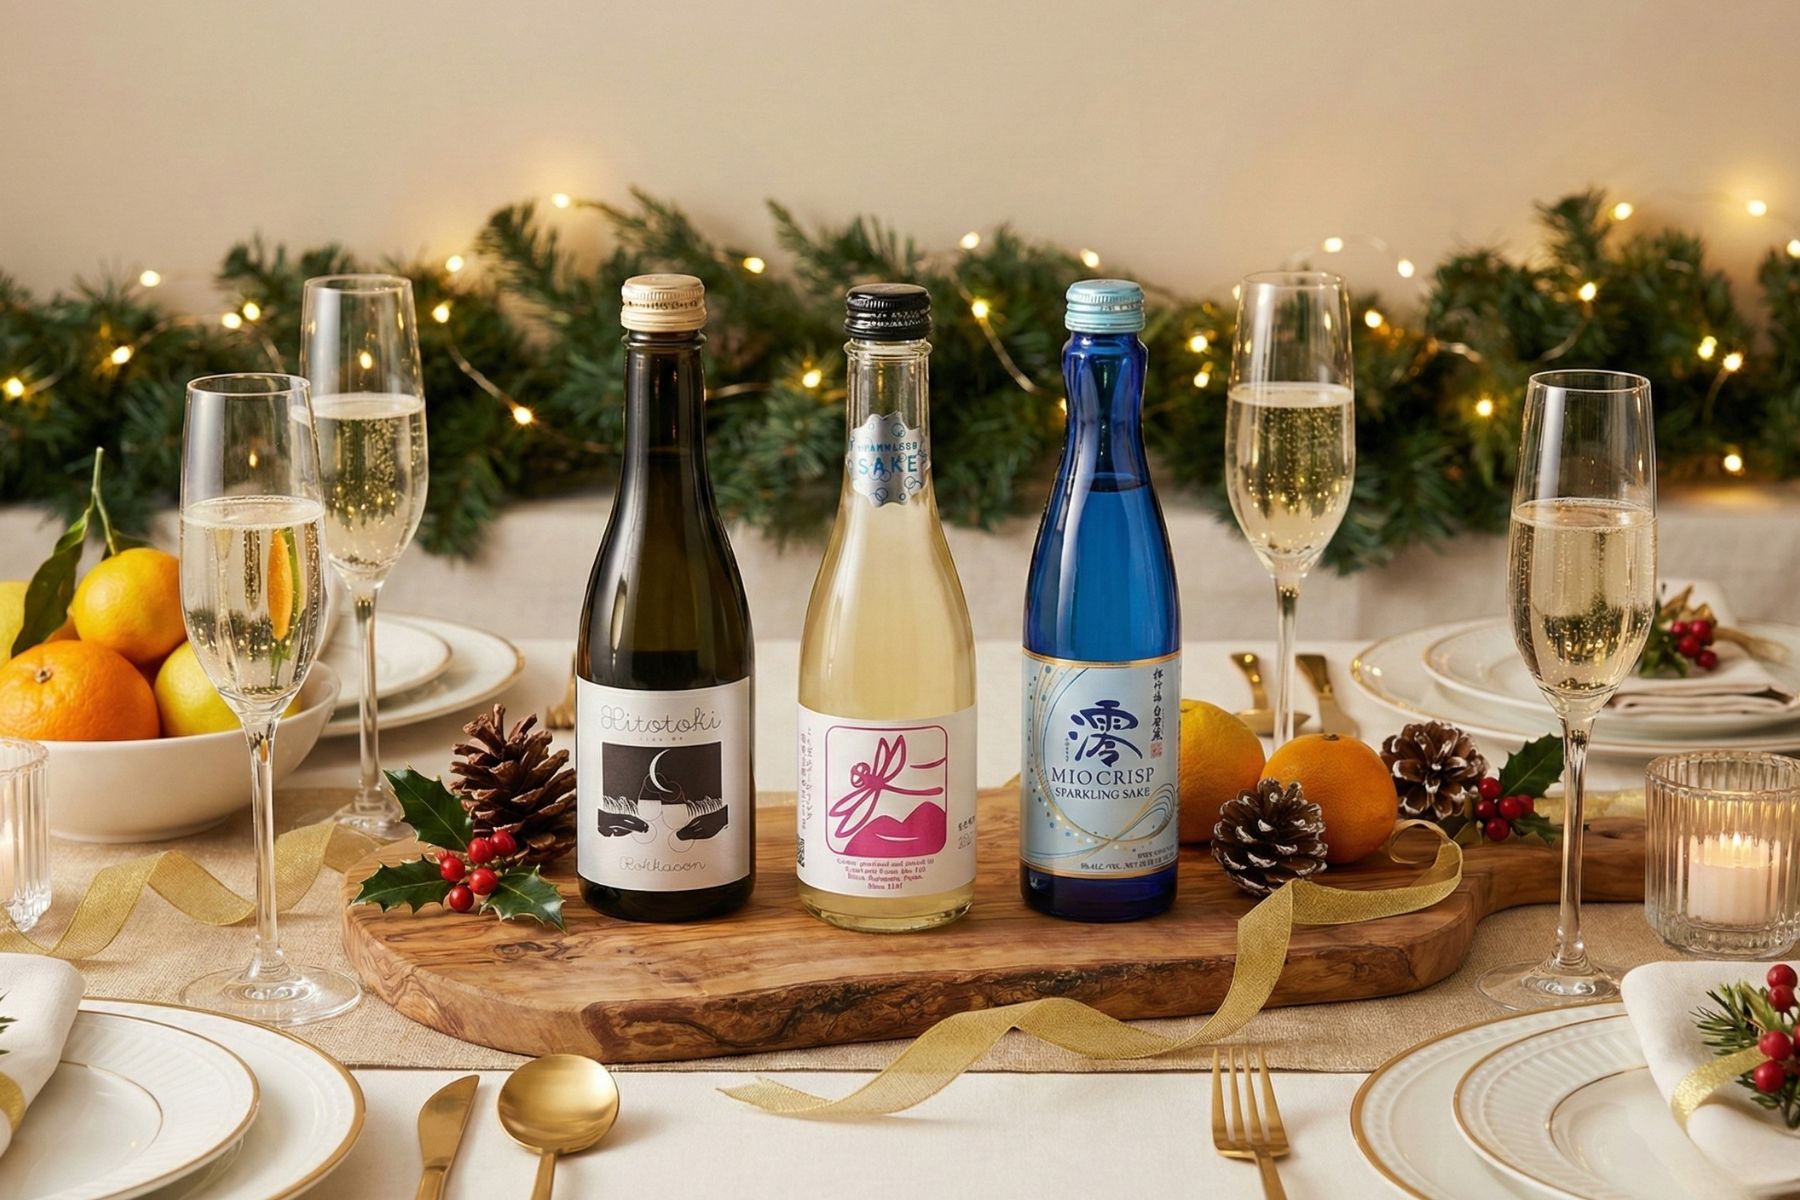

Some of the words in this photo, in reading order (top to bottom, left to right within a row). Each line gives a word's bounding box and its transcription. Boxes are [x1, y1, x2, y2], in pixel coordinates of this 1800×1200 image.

[859, 455, 918, 476] SAKE
[601, 704, 721, 734] Hitotoki
[1055, 787, 1120, 800] SPARKLING
[1123, 787, 1150, 799] SAKE
